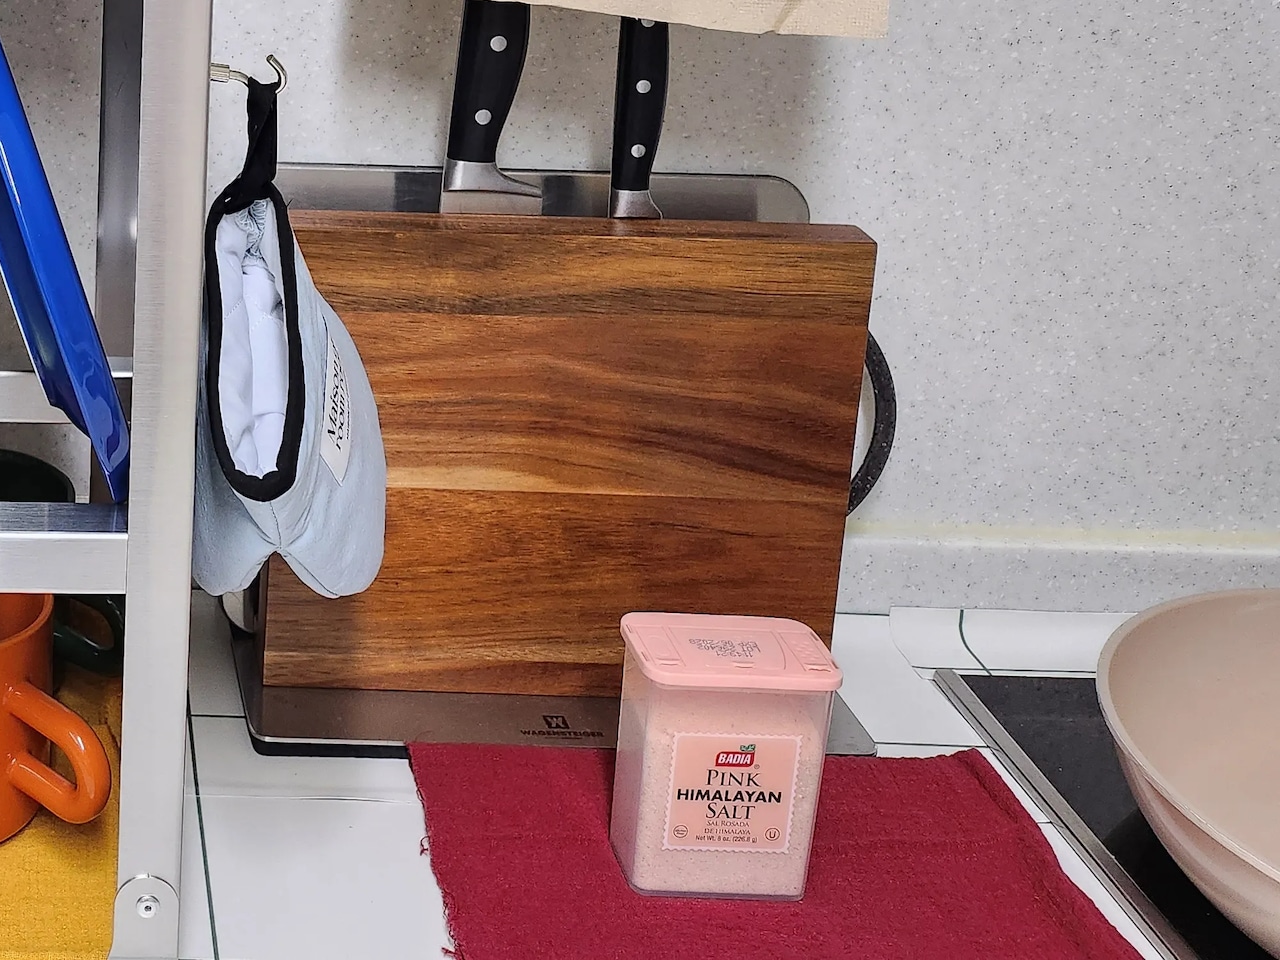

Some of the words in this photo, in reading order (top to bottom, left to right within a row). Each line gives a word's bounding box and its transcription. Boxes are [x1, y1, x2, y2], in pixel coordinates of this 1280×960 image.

[327, 359, 339, 445] Maison
[520, 729, 605, 738] WAGENSTEIGER
[717, 753, 752, 765] BADIA
[705, 768, 762, 787] PINK
[676, 788, 782, 803] HIMALAYAN
[705, 801, 756, 820] SALT
